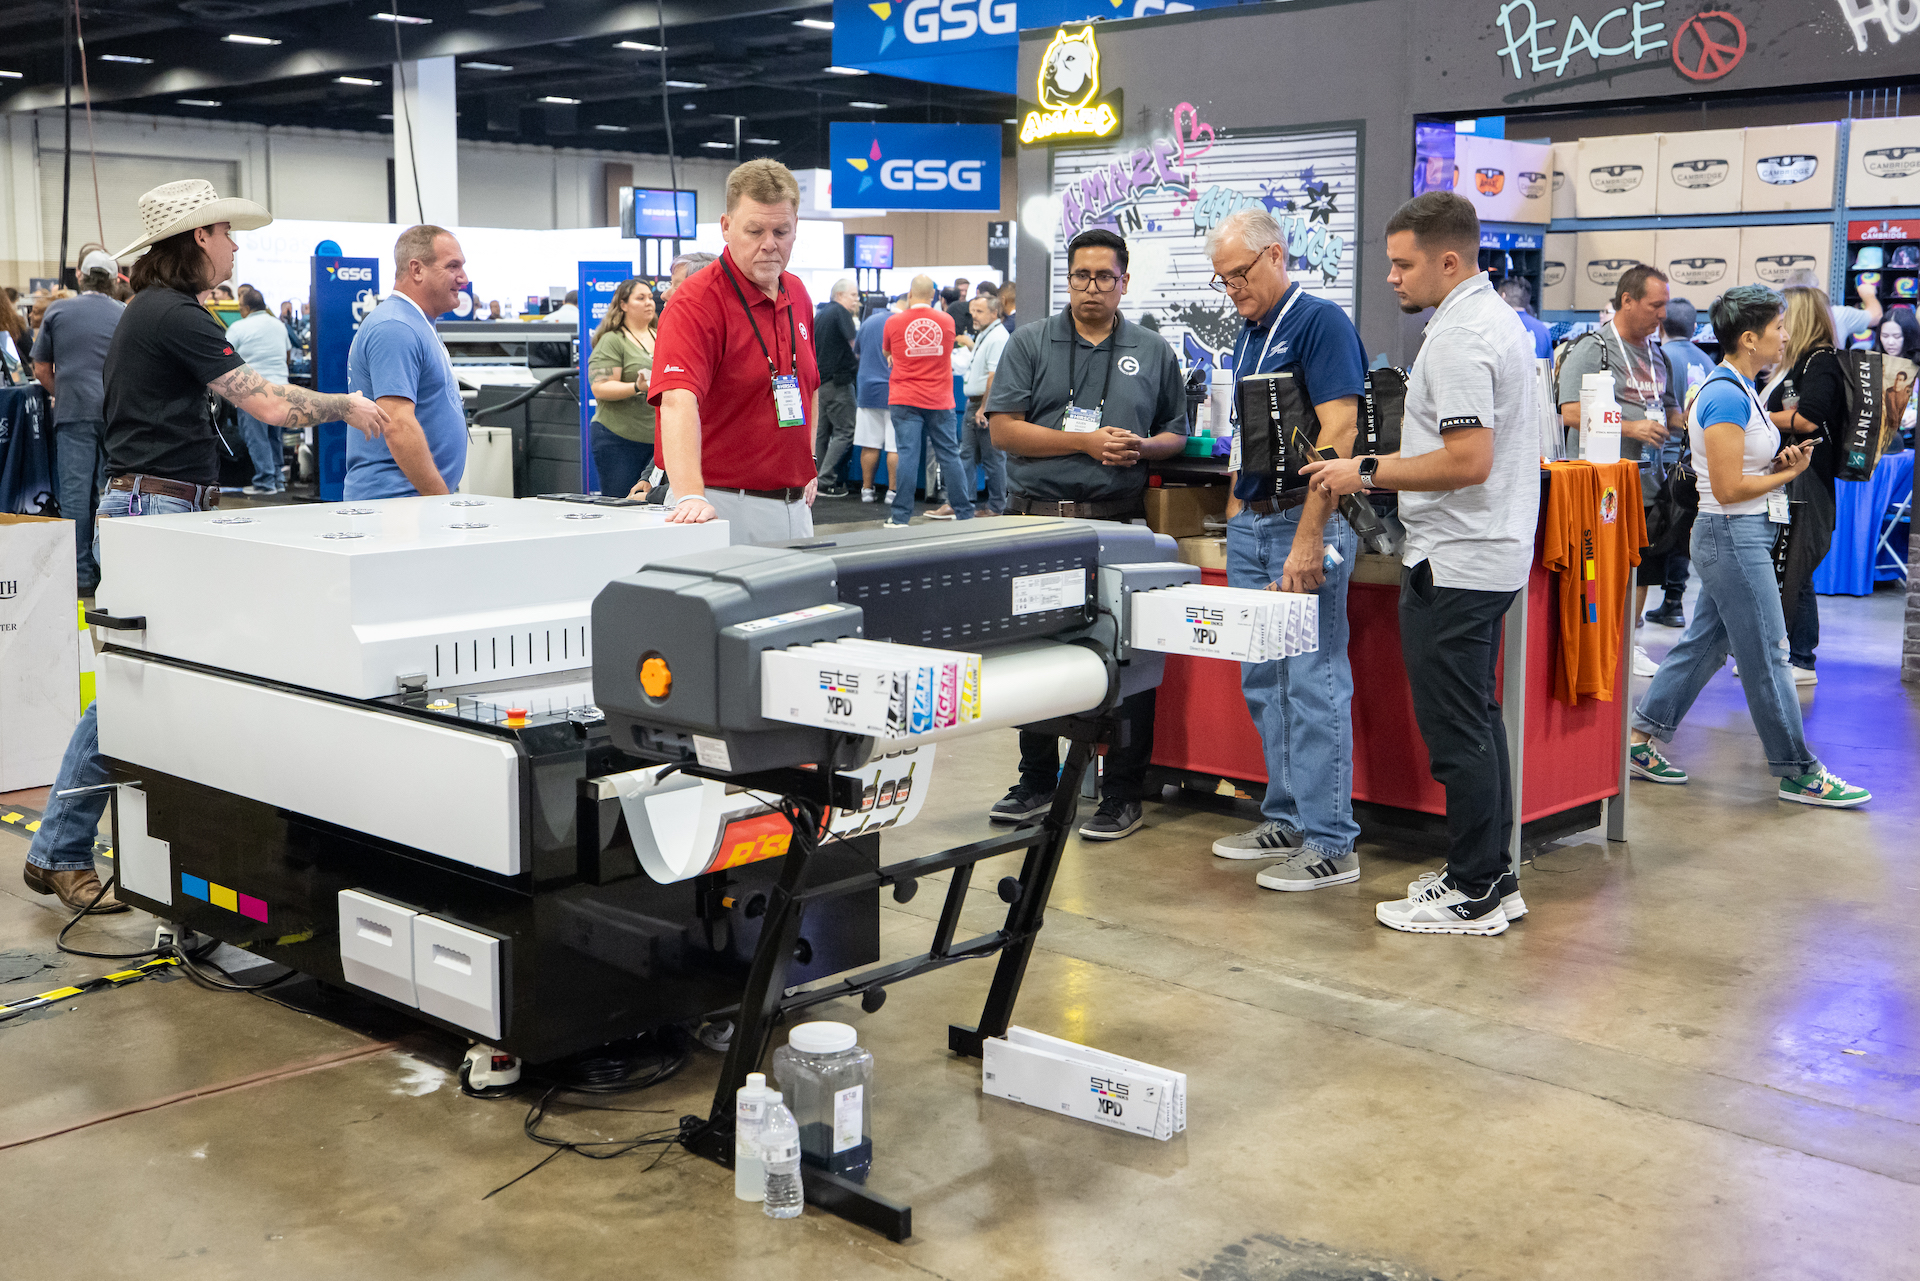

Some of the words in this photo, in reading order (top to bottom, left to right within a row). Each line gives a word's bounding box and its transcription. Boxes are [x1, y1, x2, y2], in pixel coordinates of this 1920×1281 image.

[903, 0, 1017, 44] GSG
[1496, 0, 1668, 80] PEACE
[880, 159, 982, 191] GSG
[1593, 177, 1638, 186] CAMBRIDGE
[1677, 172, 1723, 182] CAMBRIDGE
[1762, 167, 1810, 178] CAMBRIDGE
[1061, 136, 1191, 245] AMAZE
[995, 224, 1004, 237] Z
[1115, 204, 1143, 238] IN
[1861, 231, 1908, 240] CAMBRIDGE
[336, 267, 372, 281] GSG
[1674, 269, 1721, 278] CAMBRIDGE
[1860, 361, 1874, 406] SEVEN
[1270, 392, 1279, 410] LANE
[1365, 393, 1374, 415] SEVEN
[1367, 415, 1375, 433] LANE
[1442, 418, 1477, 427] OAKLEY
[1854, 409, 1873, 447] LANE
[1584, 529, 1594, 560] INKS
[1192, 627, 1218, 645] XPD
[827, 696, 853, 717] XPD
[1097, 1097, 1123, 1117] XPD
